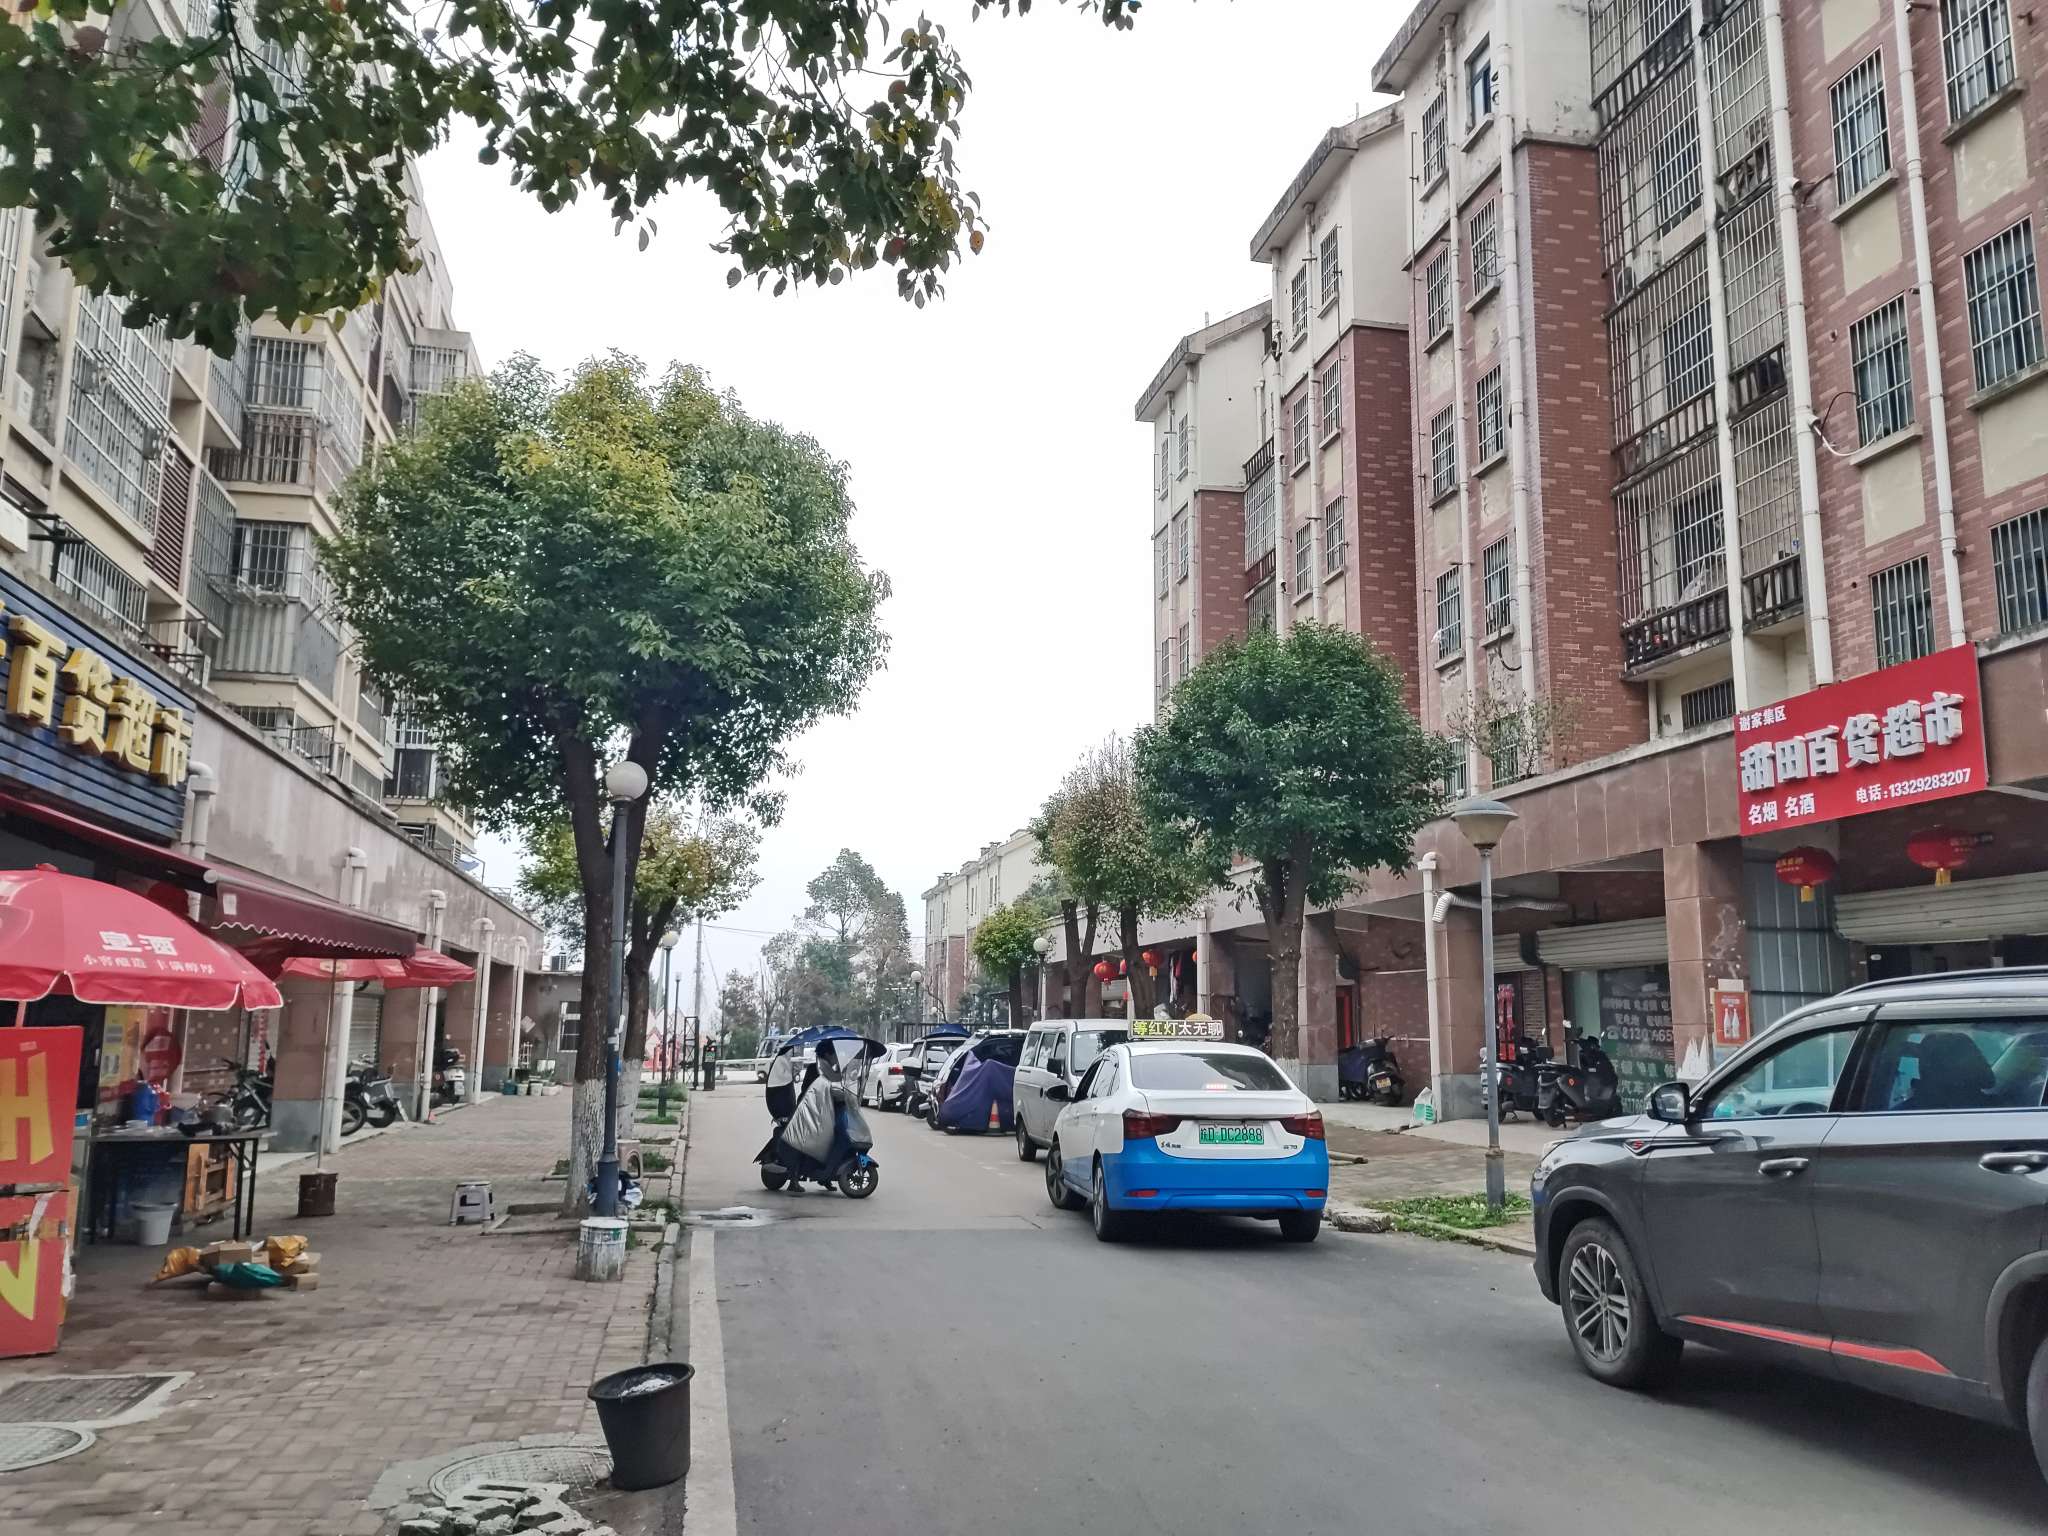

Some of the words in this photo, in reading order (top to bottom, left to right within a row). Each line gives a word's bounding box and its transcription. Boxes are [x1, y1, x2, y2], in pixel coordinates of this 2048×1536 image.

[0, 599, 192, 786] 百货超市
[1739, 705, 1787, 731] 谢家集区
[1748, 800, 1778, 825] 名烟
[1784, 793, 1815, 818] 名酒
[1133, 1021, 1222, 1036] 等红灯太无聊
